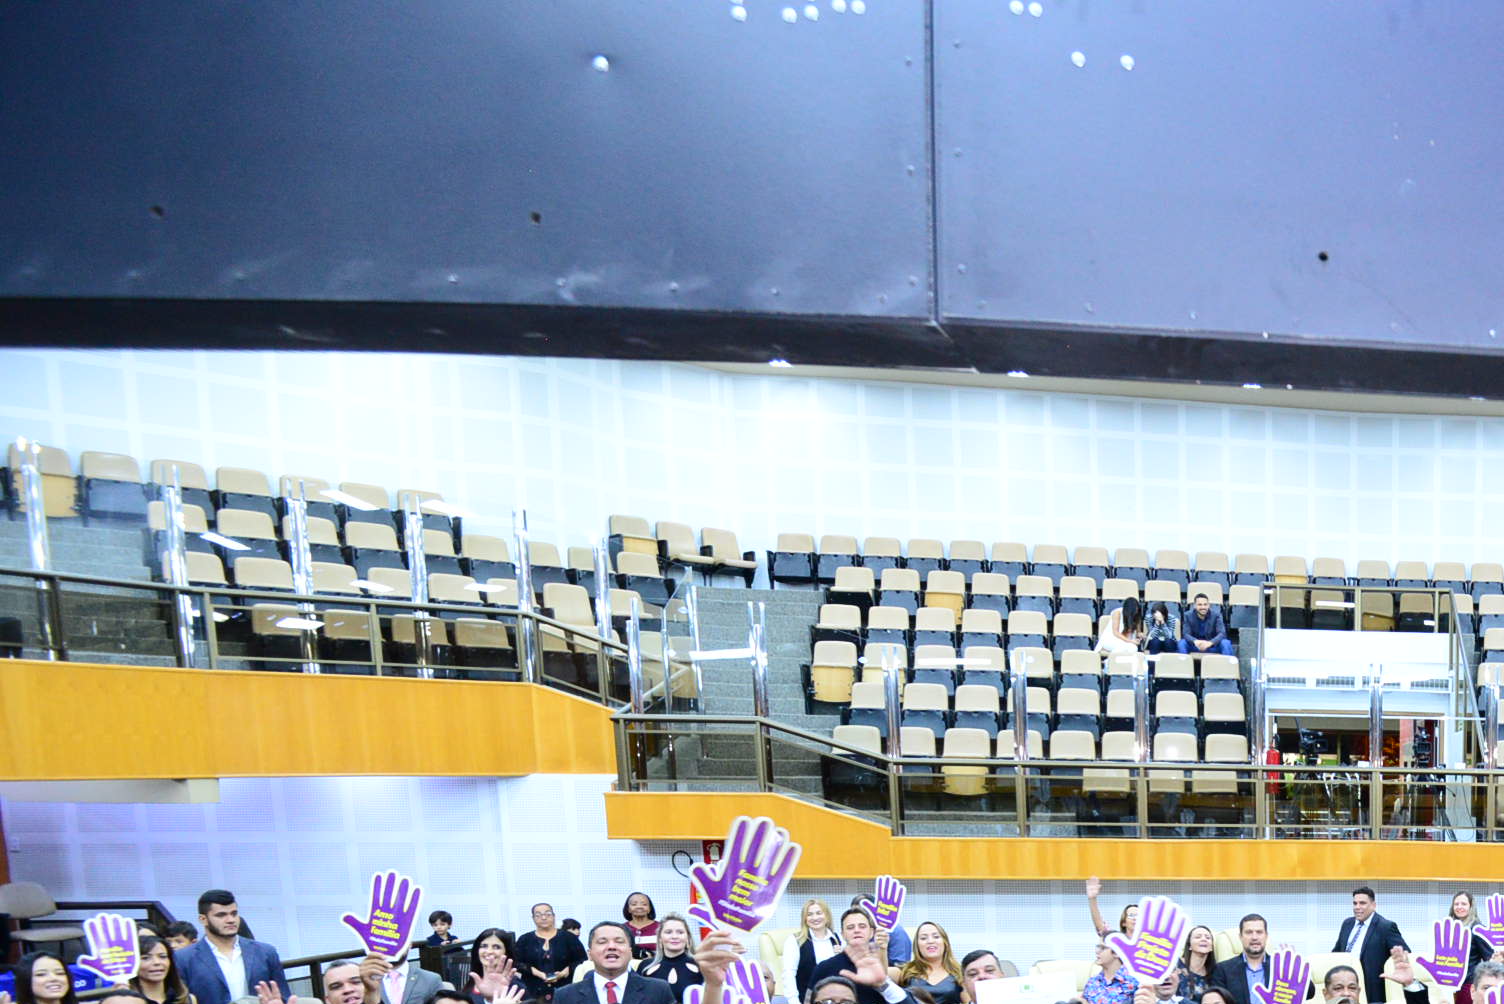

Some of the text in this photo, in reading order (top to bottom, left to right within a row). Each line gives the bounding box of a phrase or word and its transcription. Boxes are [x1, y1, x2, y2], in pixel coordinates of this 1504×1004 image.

[373, 909, 394, 920] Amo
[371, 918, 399, 930] minha
[371, 925, 401, 939] Família
